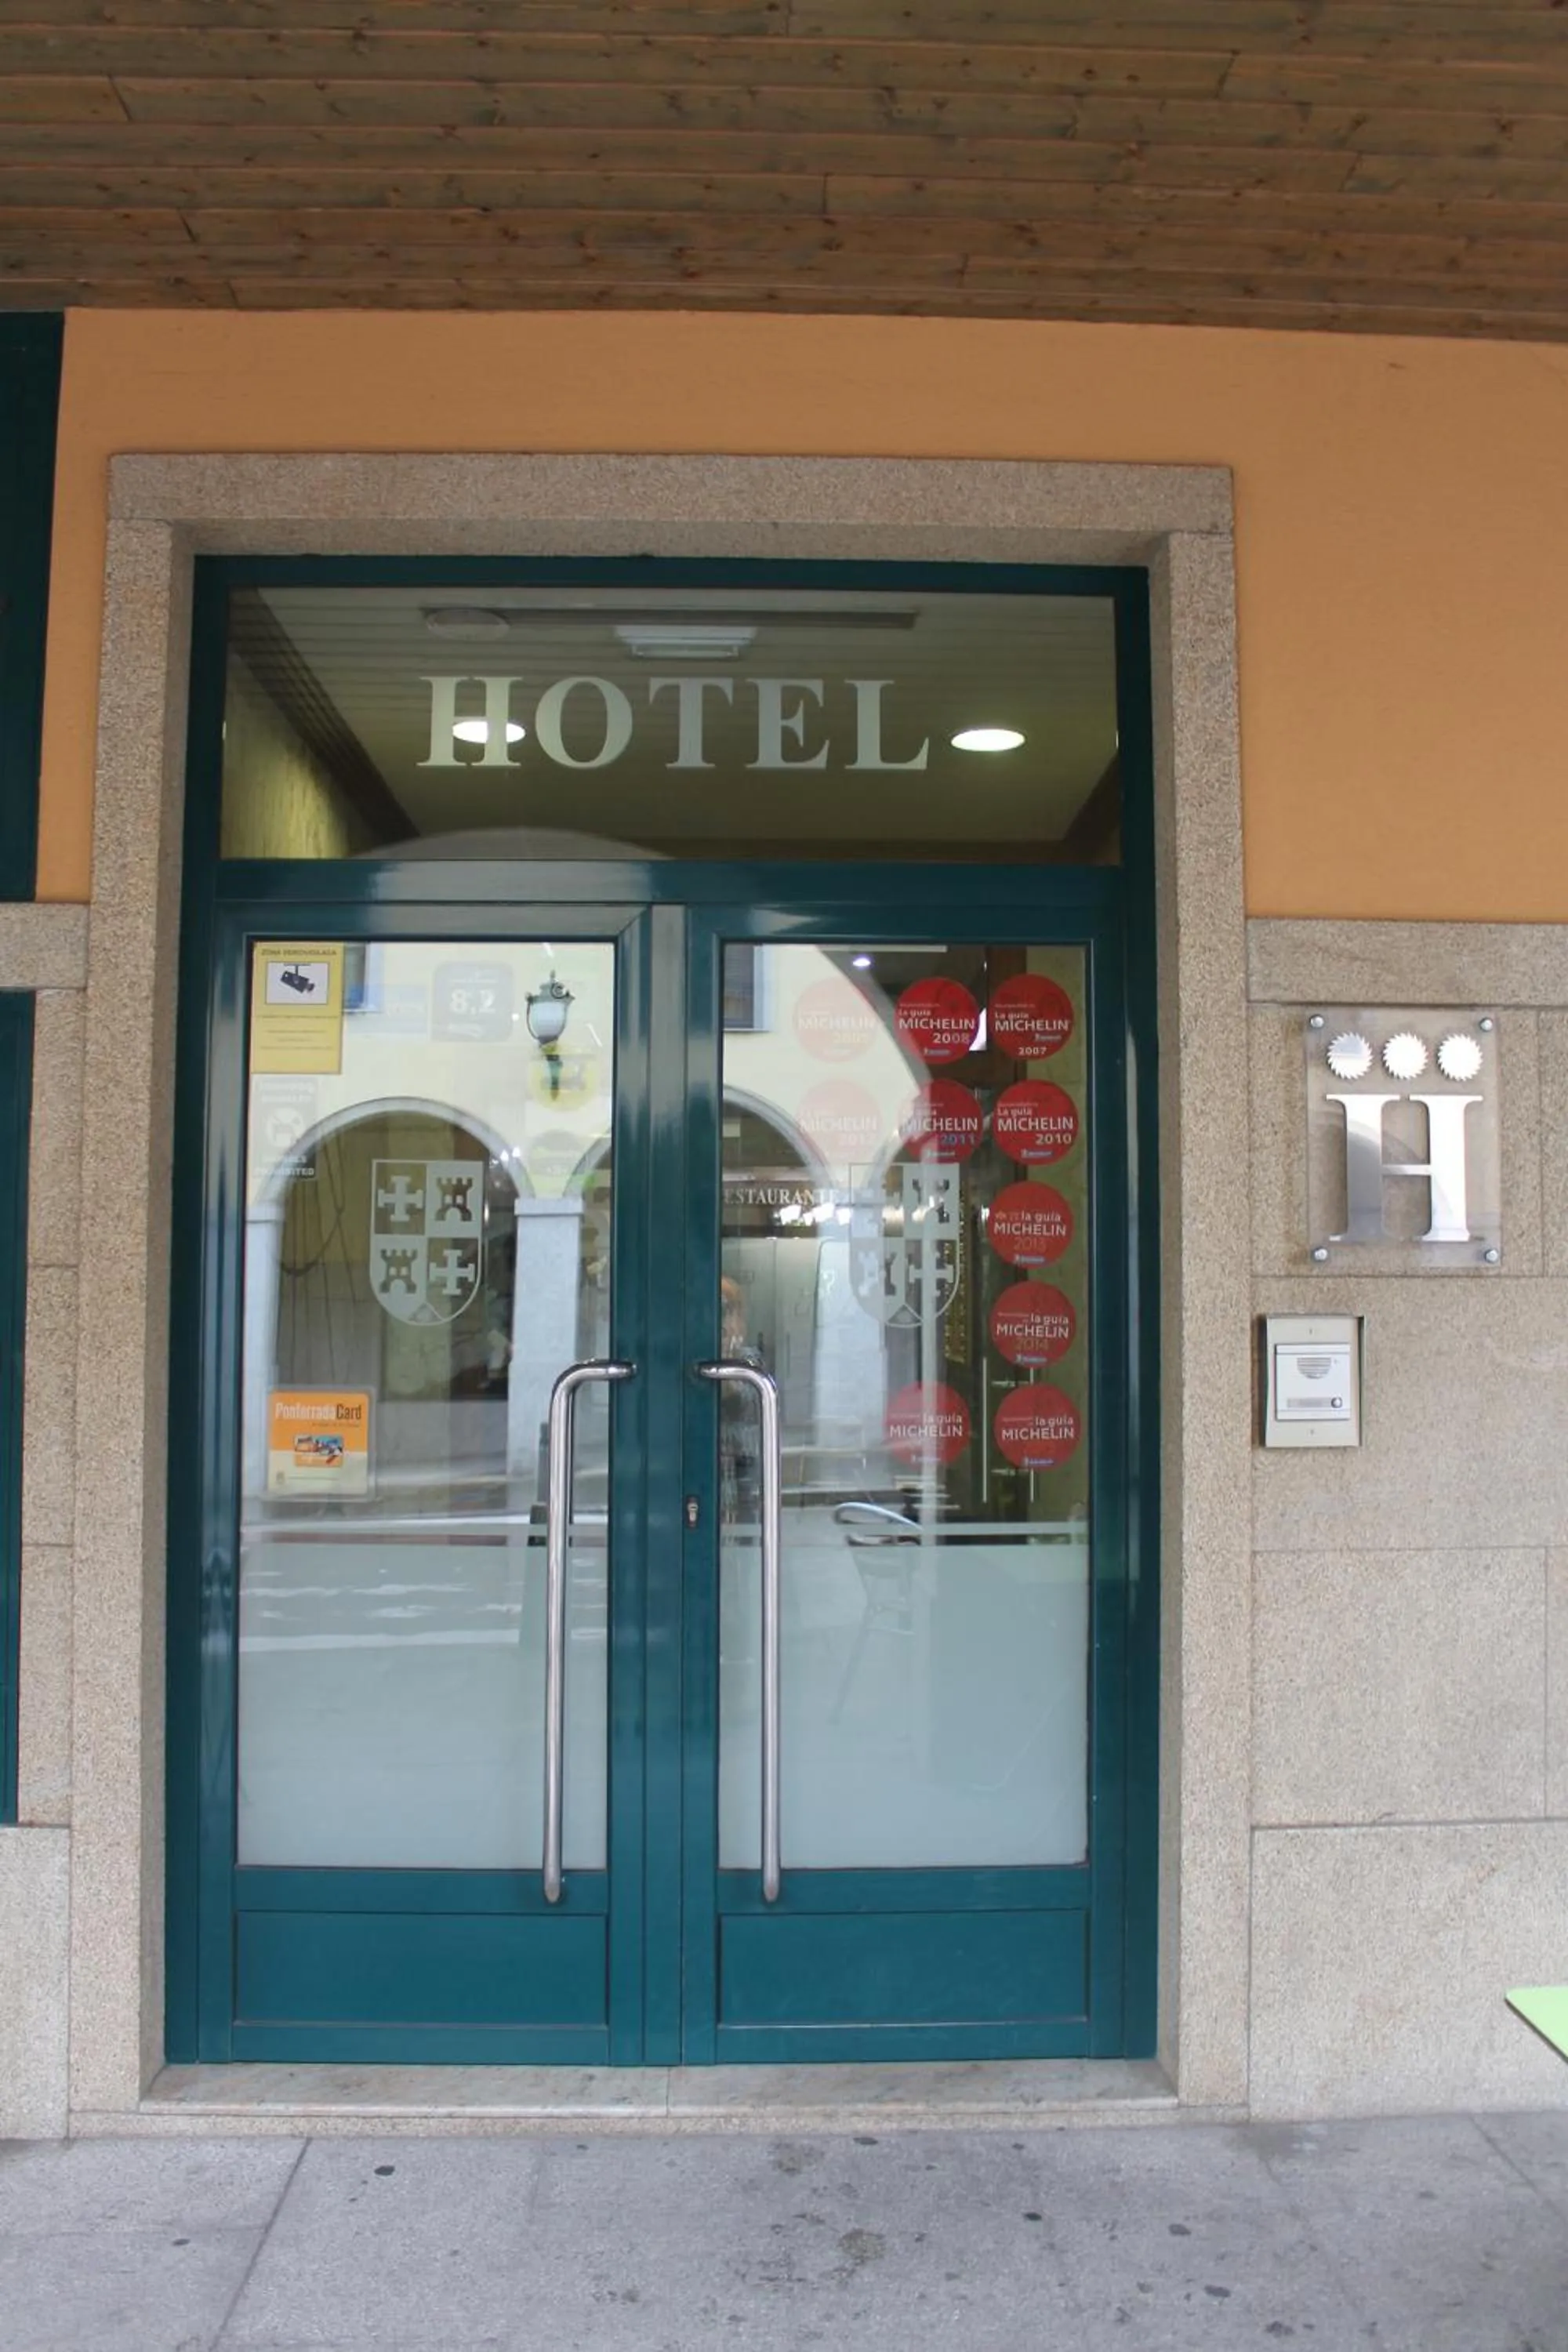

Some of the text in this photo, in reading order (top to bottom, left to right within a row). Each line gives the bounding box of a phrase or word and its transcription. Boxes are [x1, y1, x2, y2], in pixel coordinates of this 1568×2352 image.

[416, 676, 929, 770] HOTEL
[898, 1018, 975, 1030] MICHELIN
[994, 1018, 1069, 1032] MICHELIN
[932, 1032, 971, 1045] 2008
[1018, 1047, 1047, 1056] 2007
[901, 1117, 978, 1131] MICHELIN
[998, 1116, 1073, 1131] MICHELIN
[941, 1134, 975, 1145] 2011
[1035, 1133, 1073, 1145] 2010
[1327, 1094, 1483, 1242] H
[723, 1187, 840, 1206] ESTAURANTE
[993, 1222, 1066, 1236] MICHELIN
[996, 1323, 1069, 1338] MICHELIN
[889, 1425, 963, 1438] MICHELIN
[1001, 1427, 1074, 1441] MICHELIN
